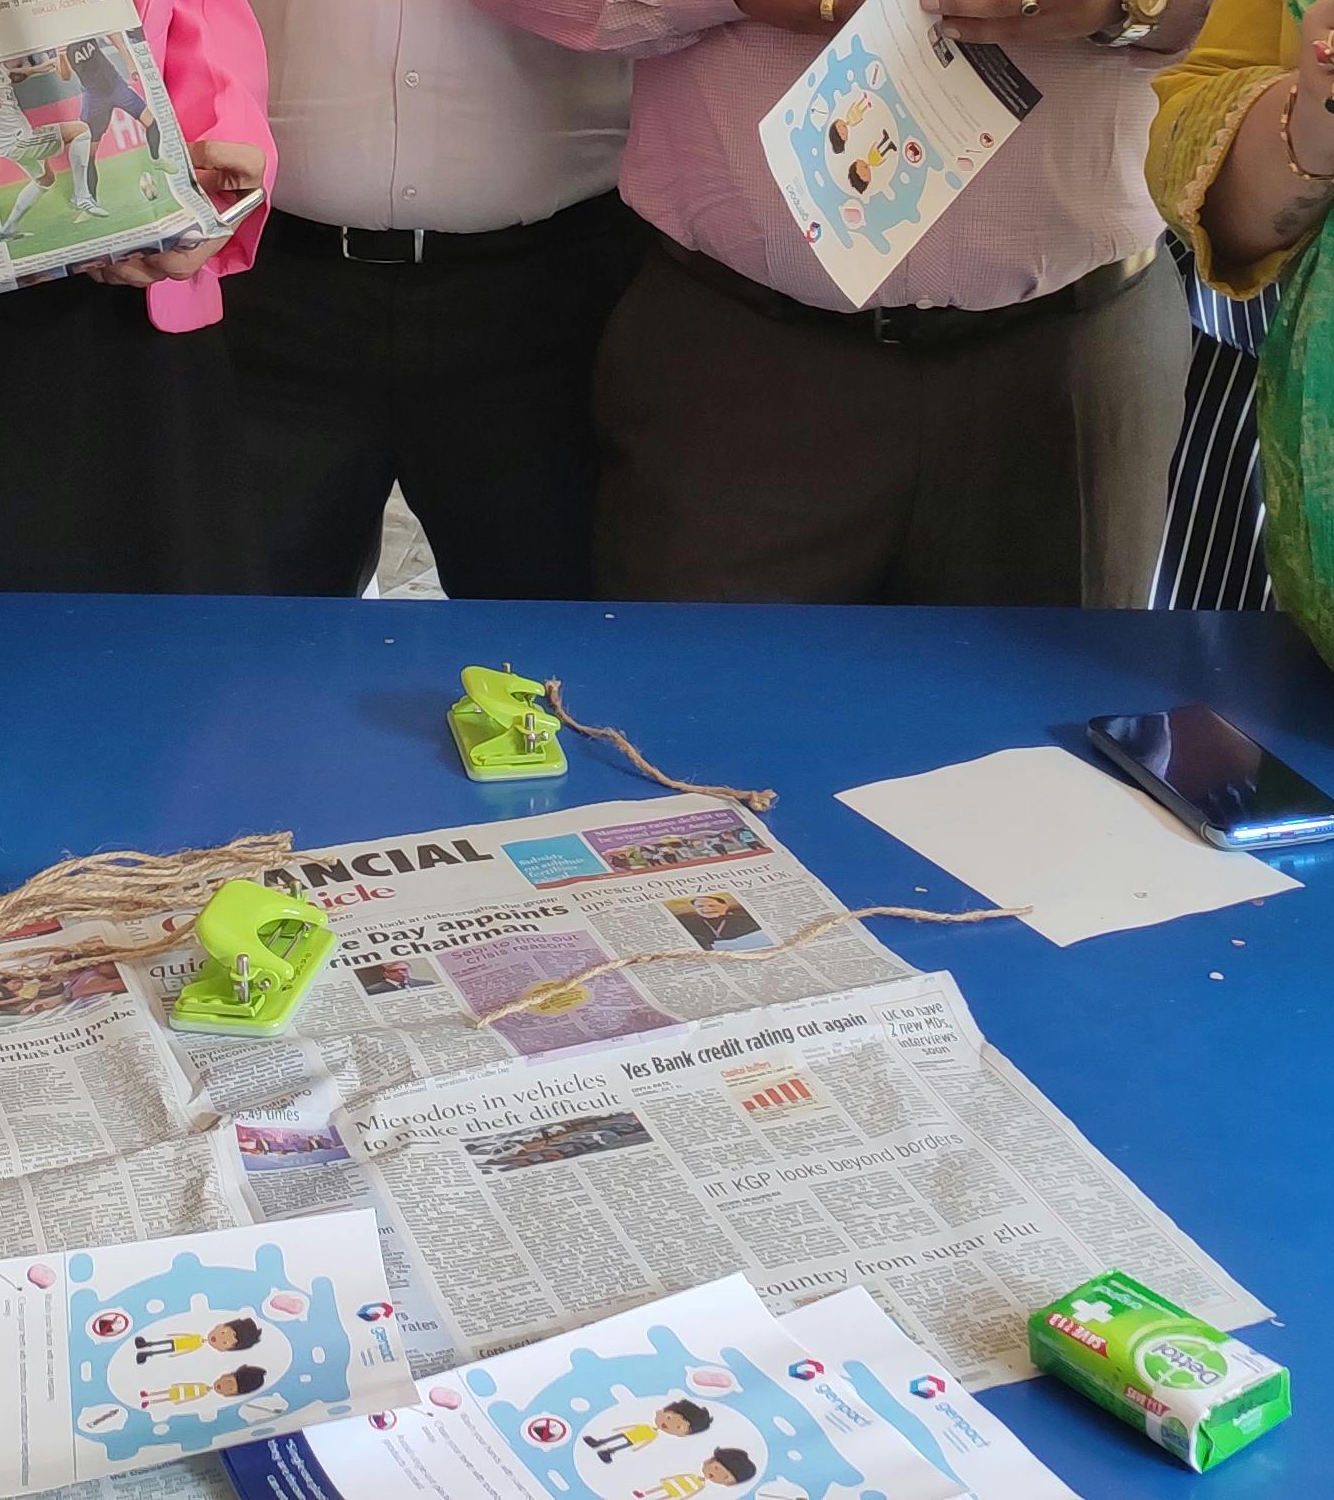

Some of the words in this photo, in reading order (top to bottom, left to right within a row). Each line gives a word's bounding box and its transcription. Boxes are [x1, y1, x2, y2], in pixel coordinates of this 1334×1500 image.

[74, 42, 97, 64] AIA
[264, 839, 497, 891] ANCIAL
[571, 881, 643, 901] Invesco
[647, 861, 773, 890] Oppenheimer
[580, 898, 613, 914] ups
[619, 890, 666, 905] stake
[670, 887, 690, 897] in
[695, 882, 728, 893] Zee
[732, 876, 754, 891] by
[368, 924, 426, 947] Day
[438, 904, 570, 934] appoints
[390, 921, 541, 958] Chairman
[517, 933, 546, 945] find
[552, 933, 580, 943] out
[466, 949, 507, 965] crisis
[512, 941, 577, 954] reasons
[84, 1008, 137, 1039] probe
[915, 1002, 944, 1017] have
[53, 1033, 106, 1054] death
[898, 1032, 959, 1049] interviews
[899, 1022, 923, 1035] new
[209, 1046, 257, 1064] become
[621, 1058, 651, 1080] Yes
[654, 1051, 695, 1074] Bank
[697, 1040, 744, 1065] credit
[746, 1026, 796, 1052] rating
[796, 1022, 822, 1039] cut
[824, 1012, 868, 1035] again
[921, 1045, 951, 1056] soon
[293, 1089, 312, 1099] IPO
[356, 1101, 477, 1136] Microdots
[482, 1095, 506, 1111] in
[512, 1071, 607, 1102] vehicles
[267, 1110, 300, 1122] times
[364, 1138, 388, 1154] to
[395, 1124, 459, 1142] make
[466, 1110, 525, 1135] theft
[528, 1091, 619, 1123] difficult
[704, 1184, 728, 1198] IIT
[731, 1174, 772, 1194] KGP
[779, 1163, 828, 1183] looks
[828, 1150, 895, 1174] beyond
[897, 1132, 964, 1158] borders
[854, 1254, 917, 1277] from
[921, 1233, 987, 1261] sugar
[992, 1222, 1041, 1246] glut
[401, 1320, 439, 1333] rates
[1152, 1342, 1218, 1385] Dettol
[815, 1383, 874, 1427] genpact
[935, 1402, 992, 1448] genpact
